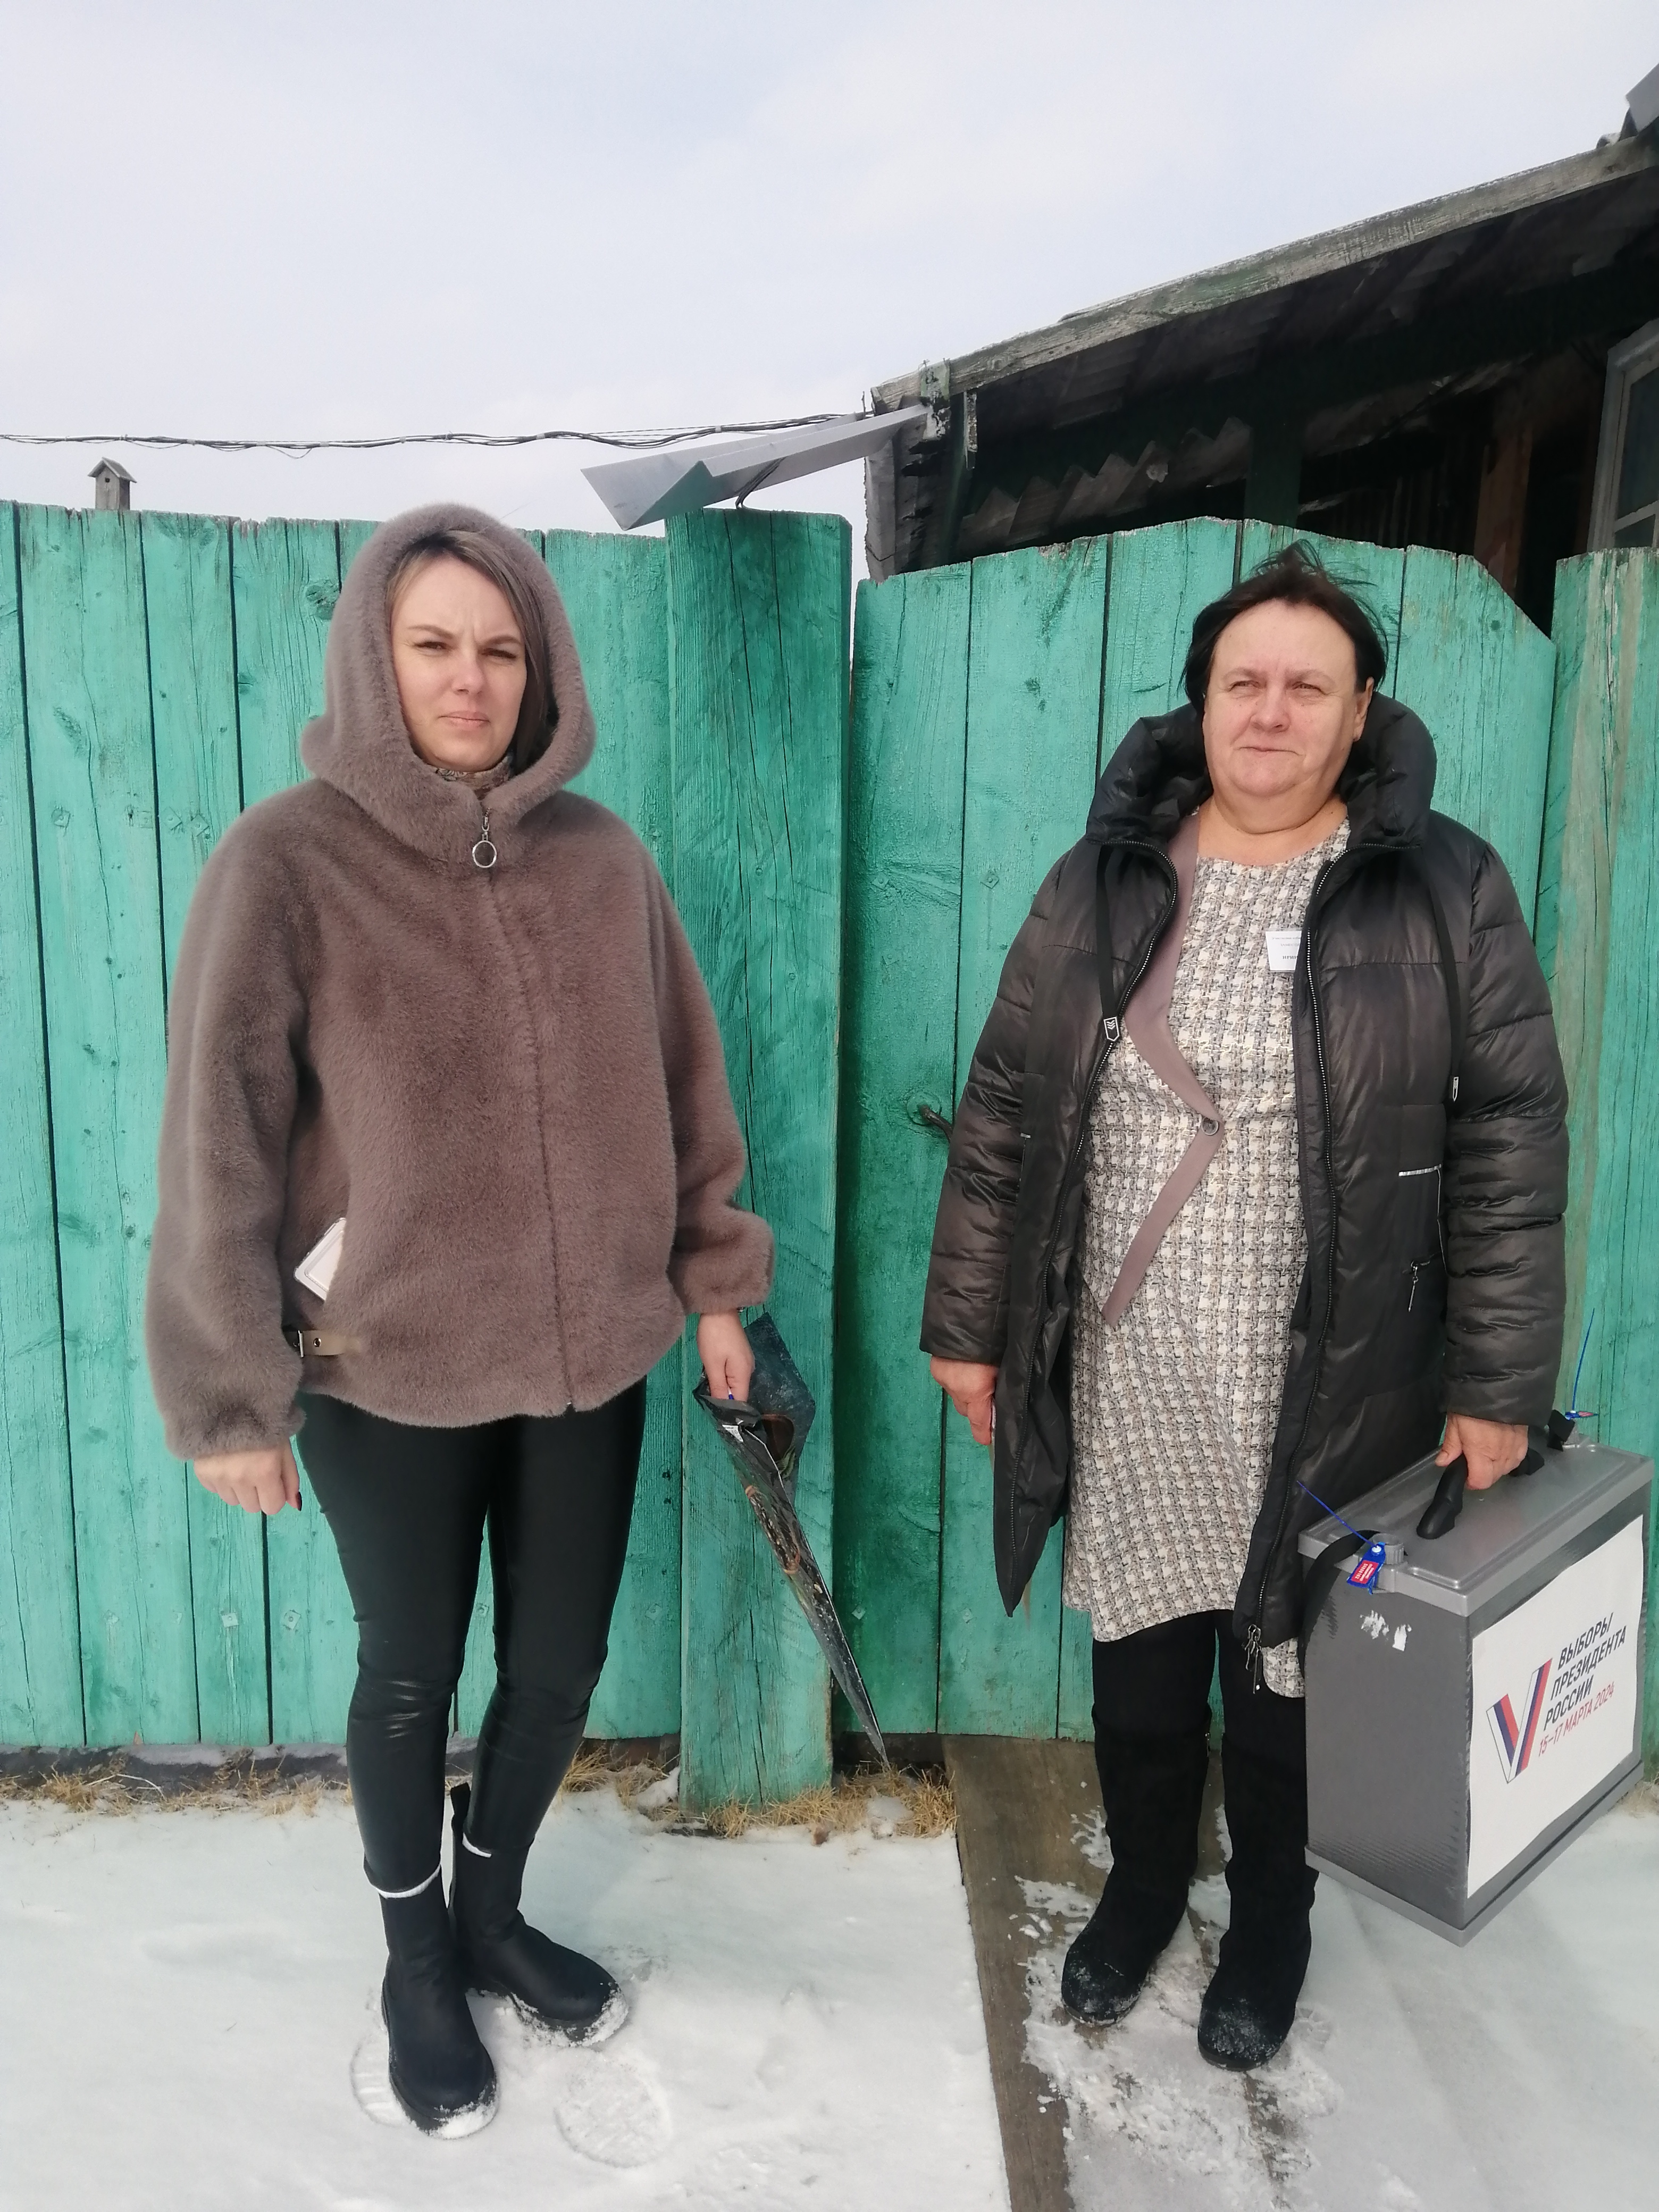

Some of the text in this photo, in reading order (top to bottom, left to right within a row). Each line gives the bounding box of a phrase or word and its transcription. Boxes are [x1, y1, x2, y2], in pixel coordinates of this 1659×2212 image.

[1550, 1625, 1627, 1700] ПРЕЗИДЕНТА
[1557, 1612, 1614, 1670] ВЫБОРЫ
[1543, 1674, 1594, 1731] РОССИИ
[1563, 1698, 1593, 1736] МАРТА
[1593, 1681, 1614, 1712] 2024
